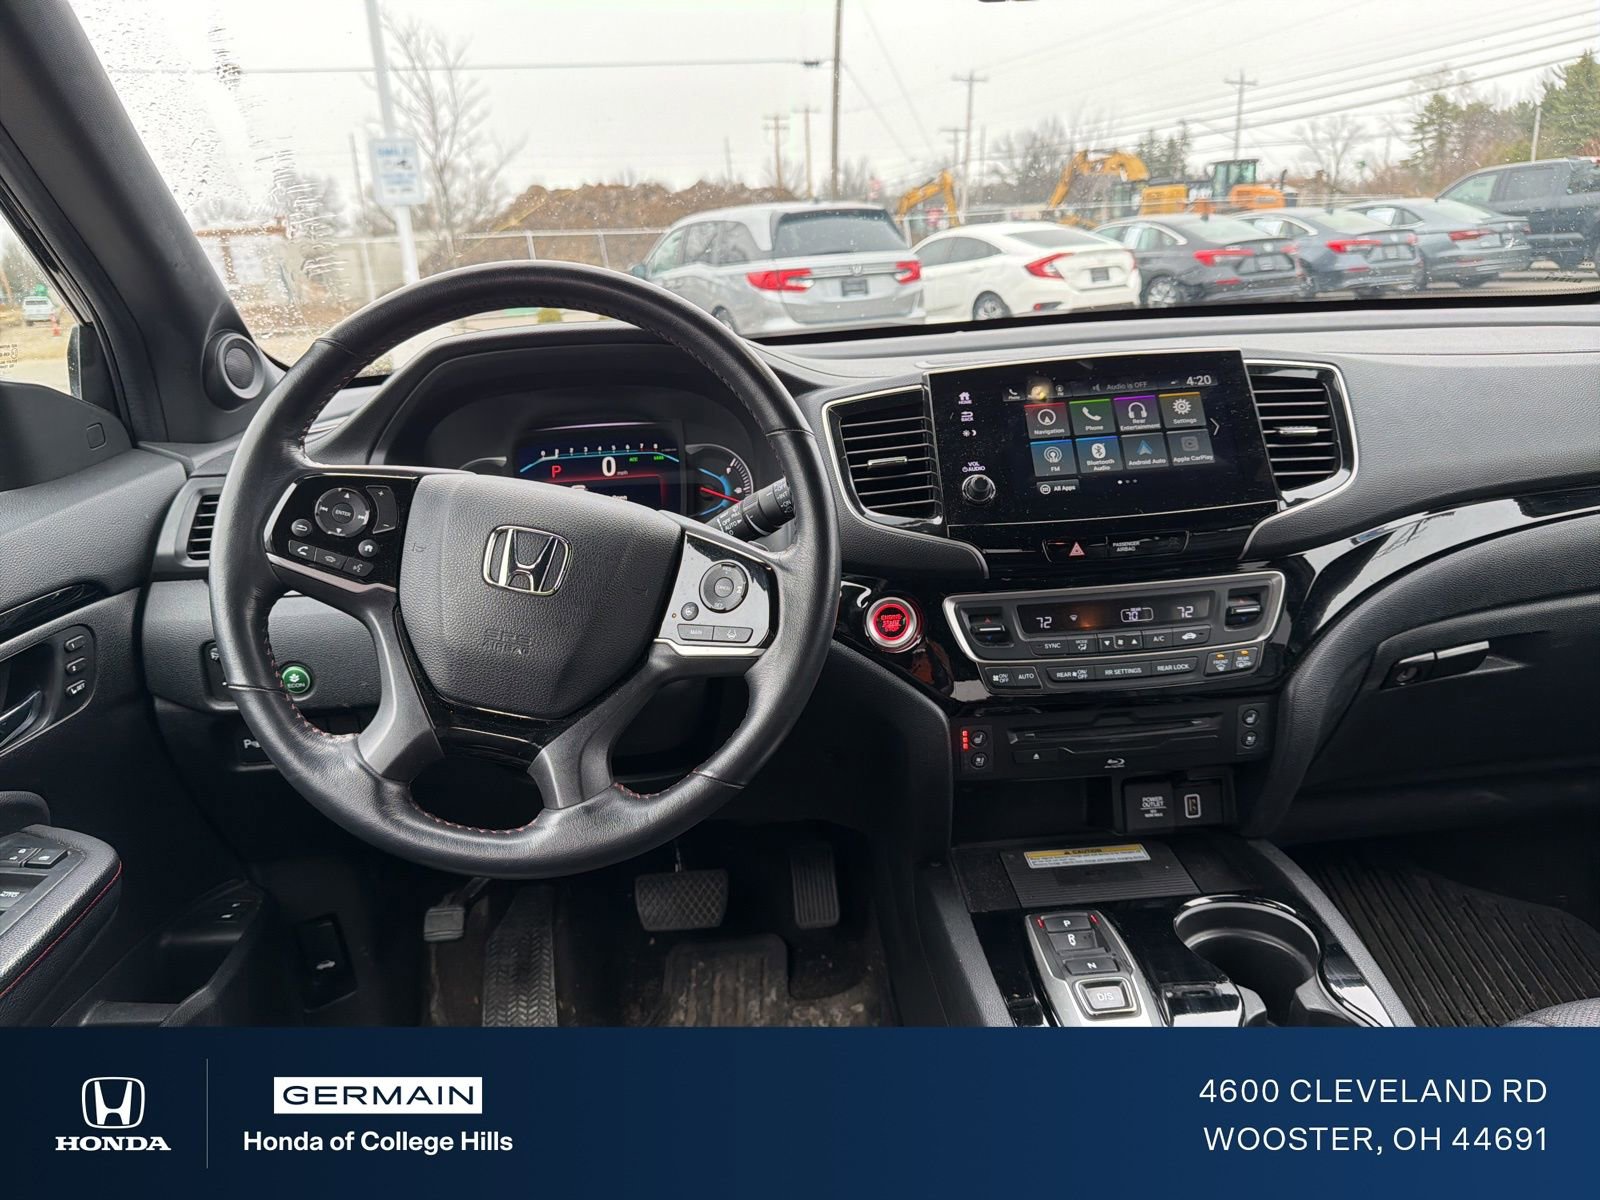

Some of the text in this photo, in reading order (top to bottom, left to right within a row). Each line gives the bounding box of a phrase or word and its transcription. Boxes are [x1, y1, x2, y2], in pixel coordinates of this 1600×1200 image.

[1187, 375, 1212, 386] 4:20
[1173, 417, 1197, 425] Settings
[1120, 423, 1160, 431] Entertainment
[602, 456, 616, 477] 0
[551, 465, 562, 479] P
[1062, 484, 1076, 492] Apps
[335, 508, 351, 517] ENTER
[725, 521, 738, 531] AUTO
[1126, 611, 1138, 621] 70
[1177, 605, 1194, 618] 72
[1036, 616, 1052, 629] 72
[1114, 667, 1142, 675] SETTINGS
[1063, 919, 1071, 928] P
[1096, 992, 1114, 1001] D/S
